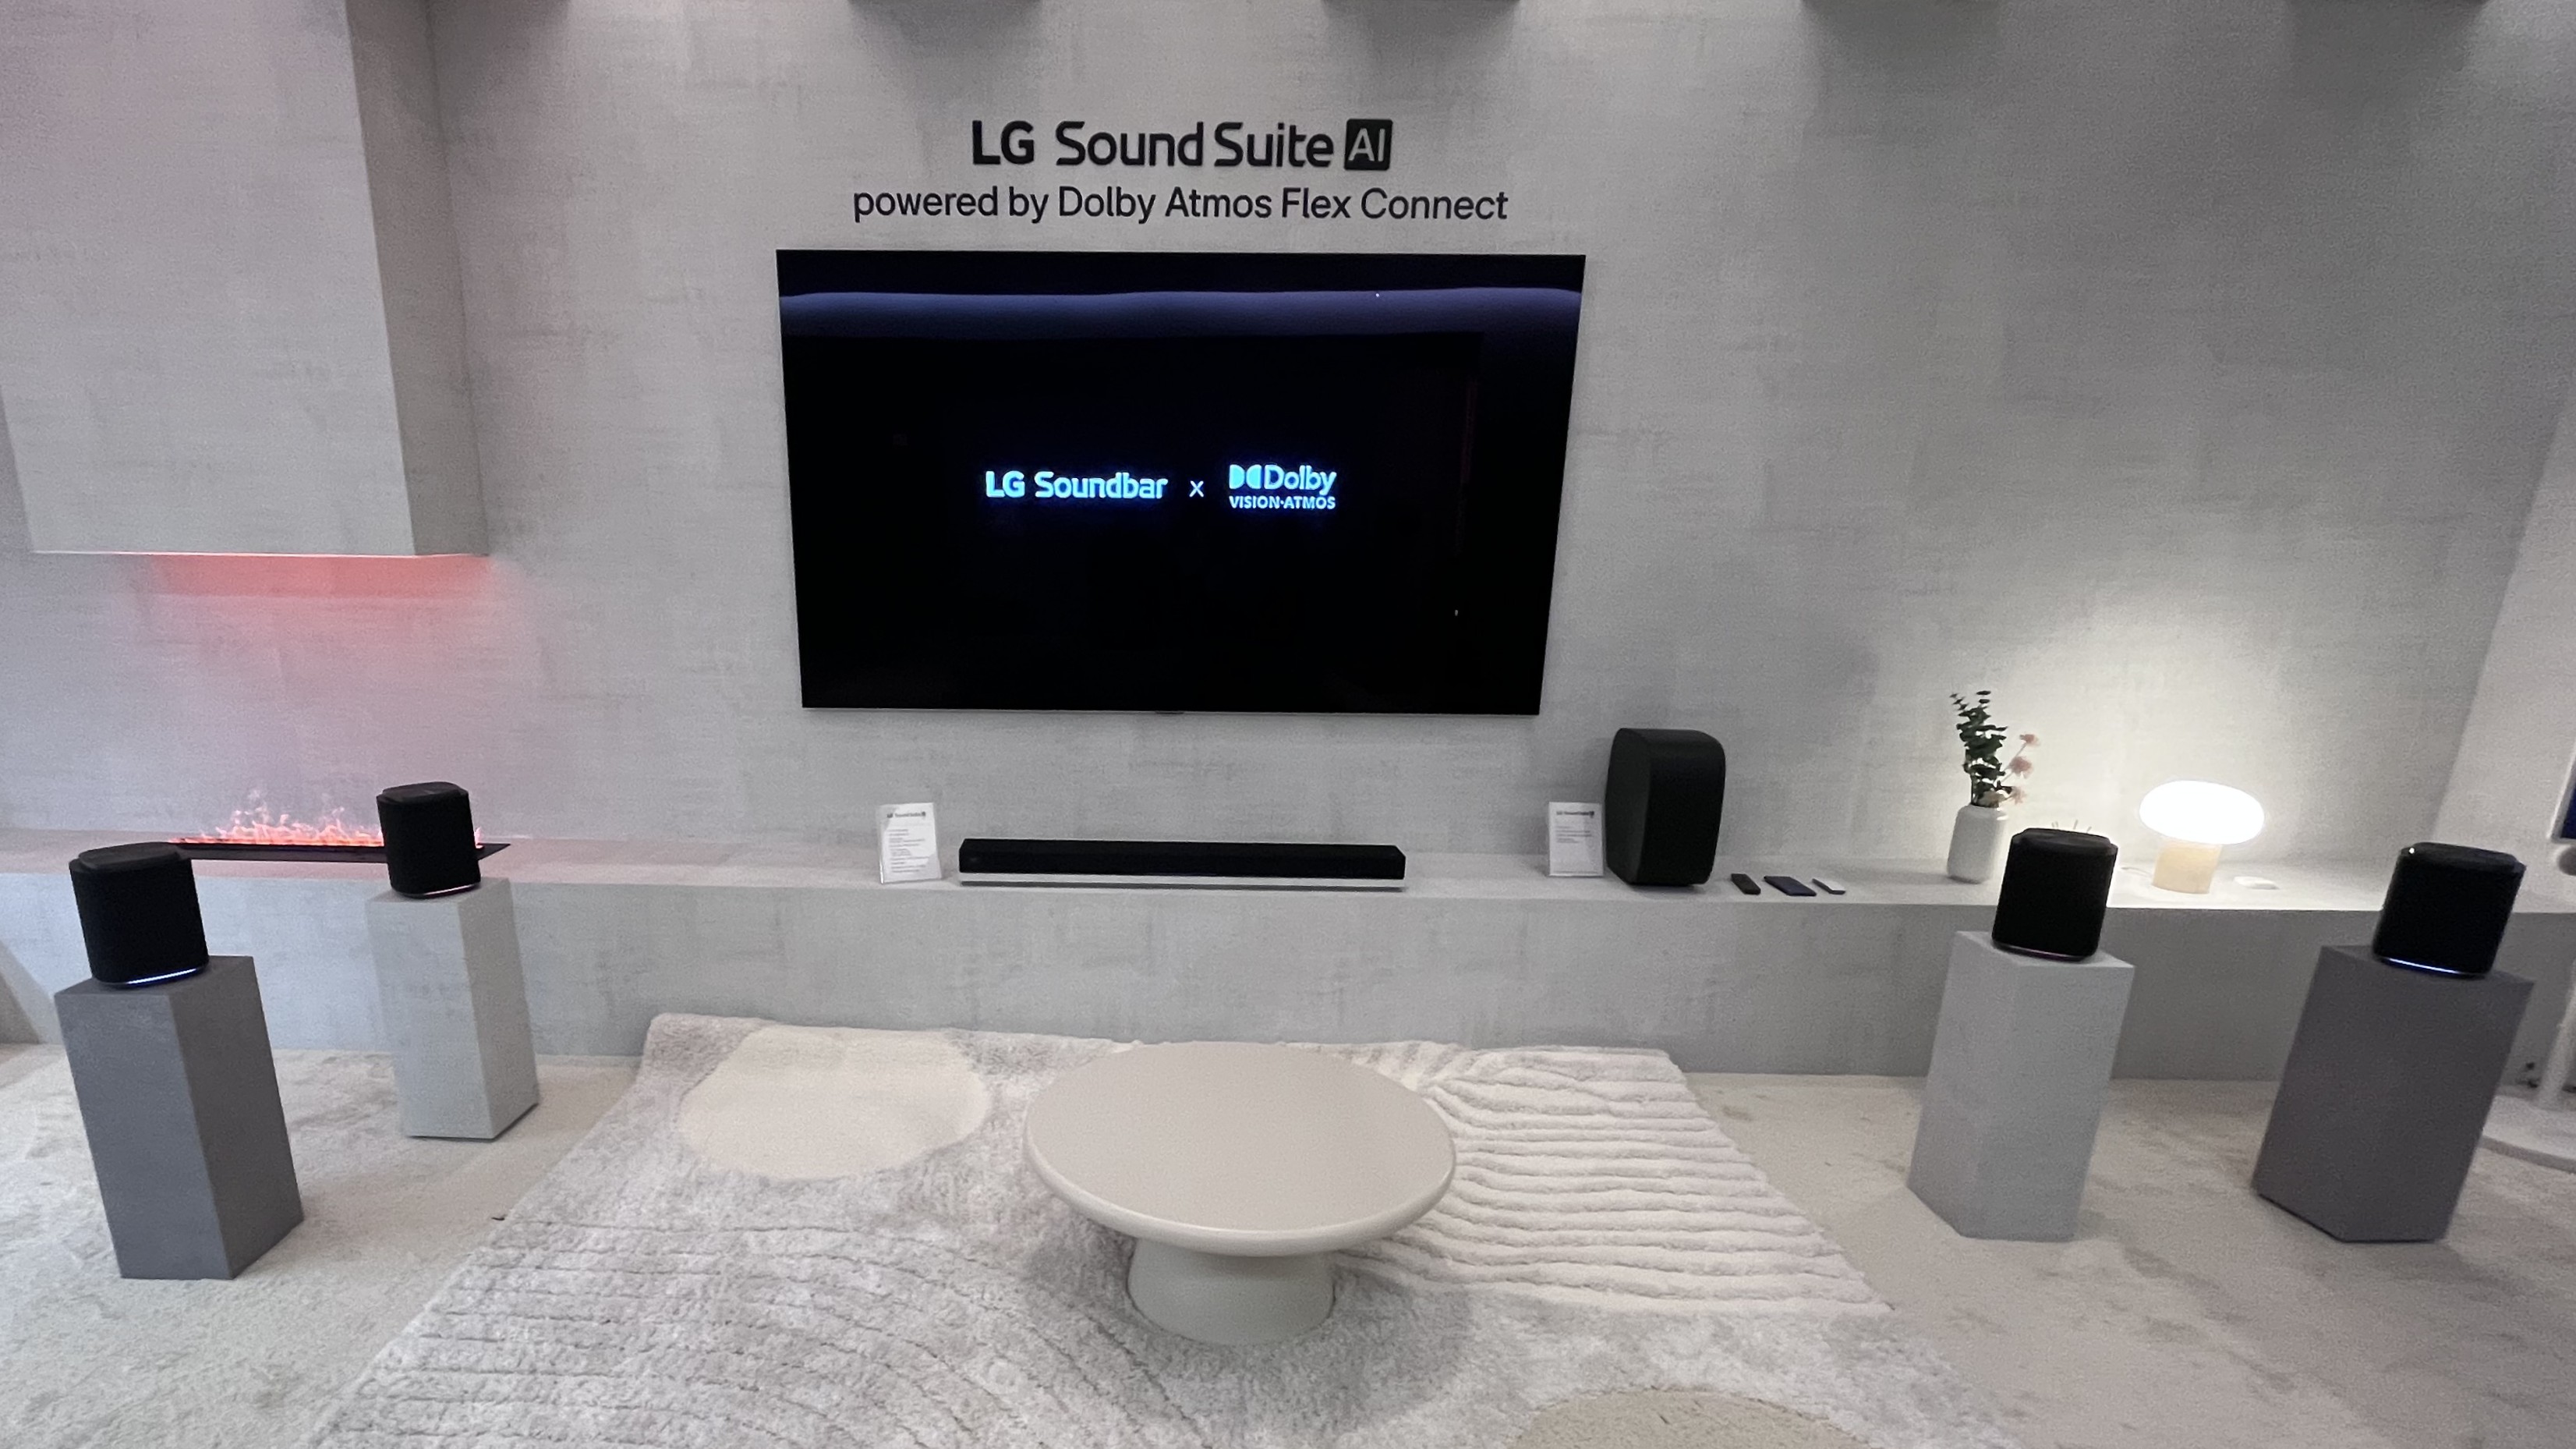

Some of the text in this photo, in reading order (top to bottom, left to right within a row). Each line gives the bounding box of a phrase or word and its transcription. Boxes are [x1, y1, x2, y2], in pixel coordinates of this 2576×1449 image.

[971, 119, 1388, 168] LG Sound Suite AI
[853, 185, 1509, 225] powered by Dolby Atmos Flex Connect
[985, 470, 1025, 498] LG
[1034, 470, 1169, 499] Soundbar
[1264, 464, 1337, 495] Dolby
